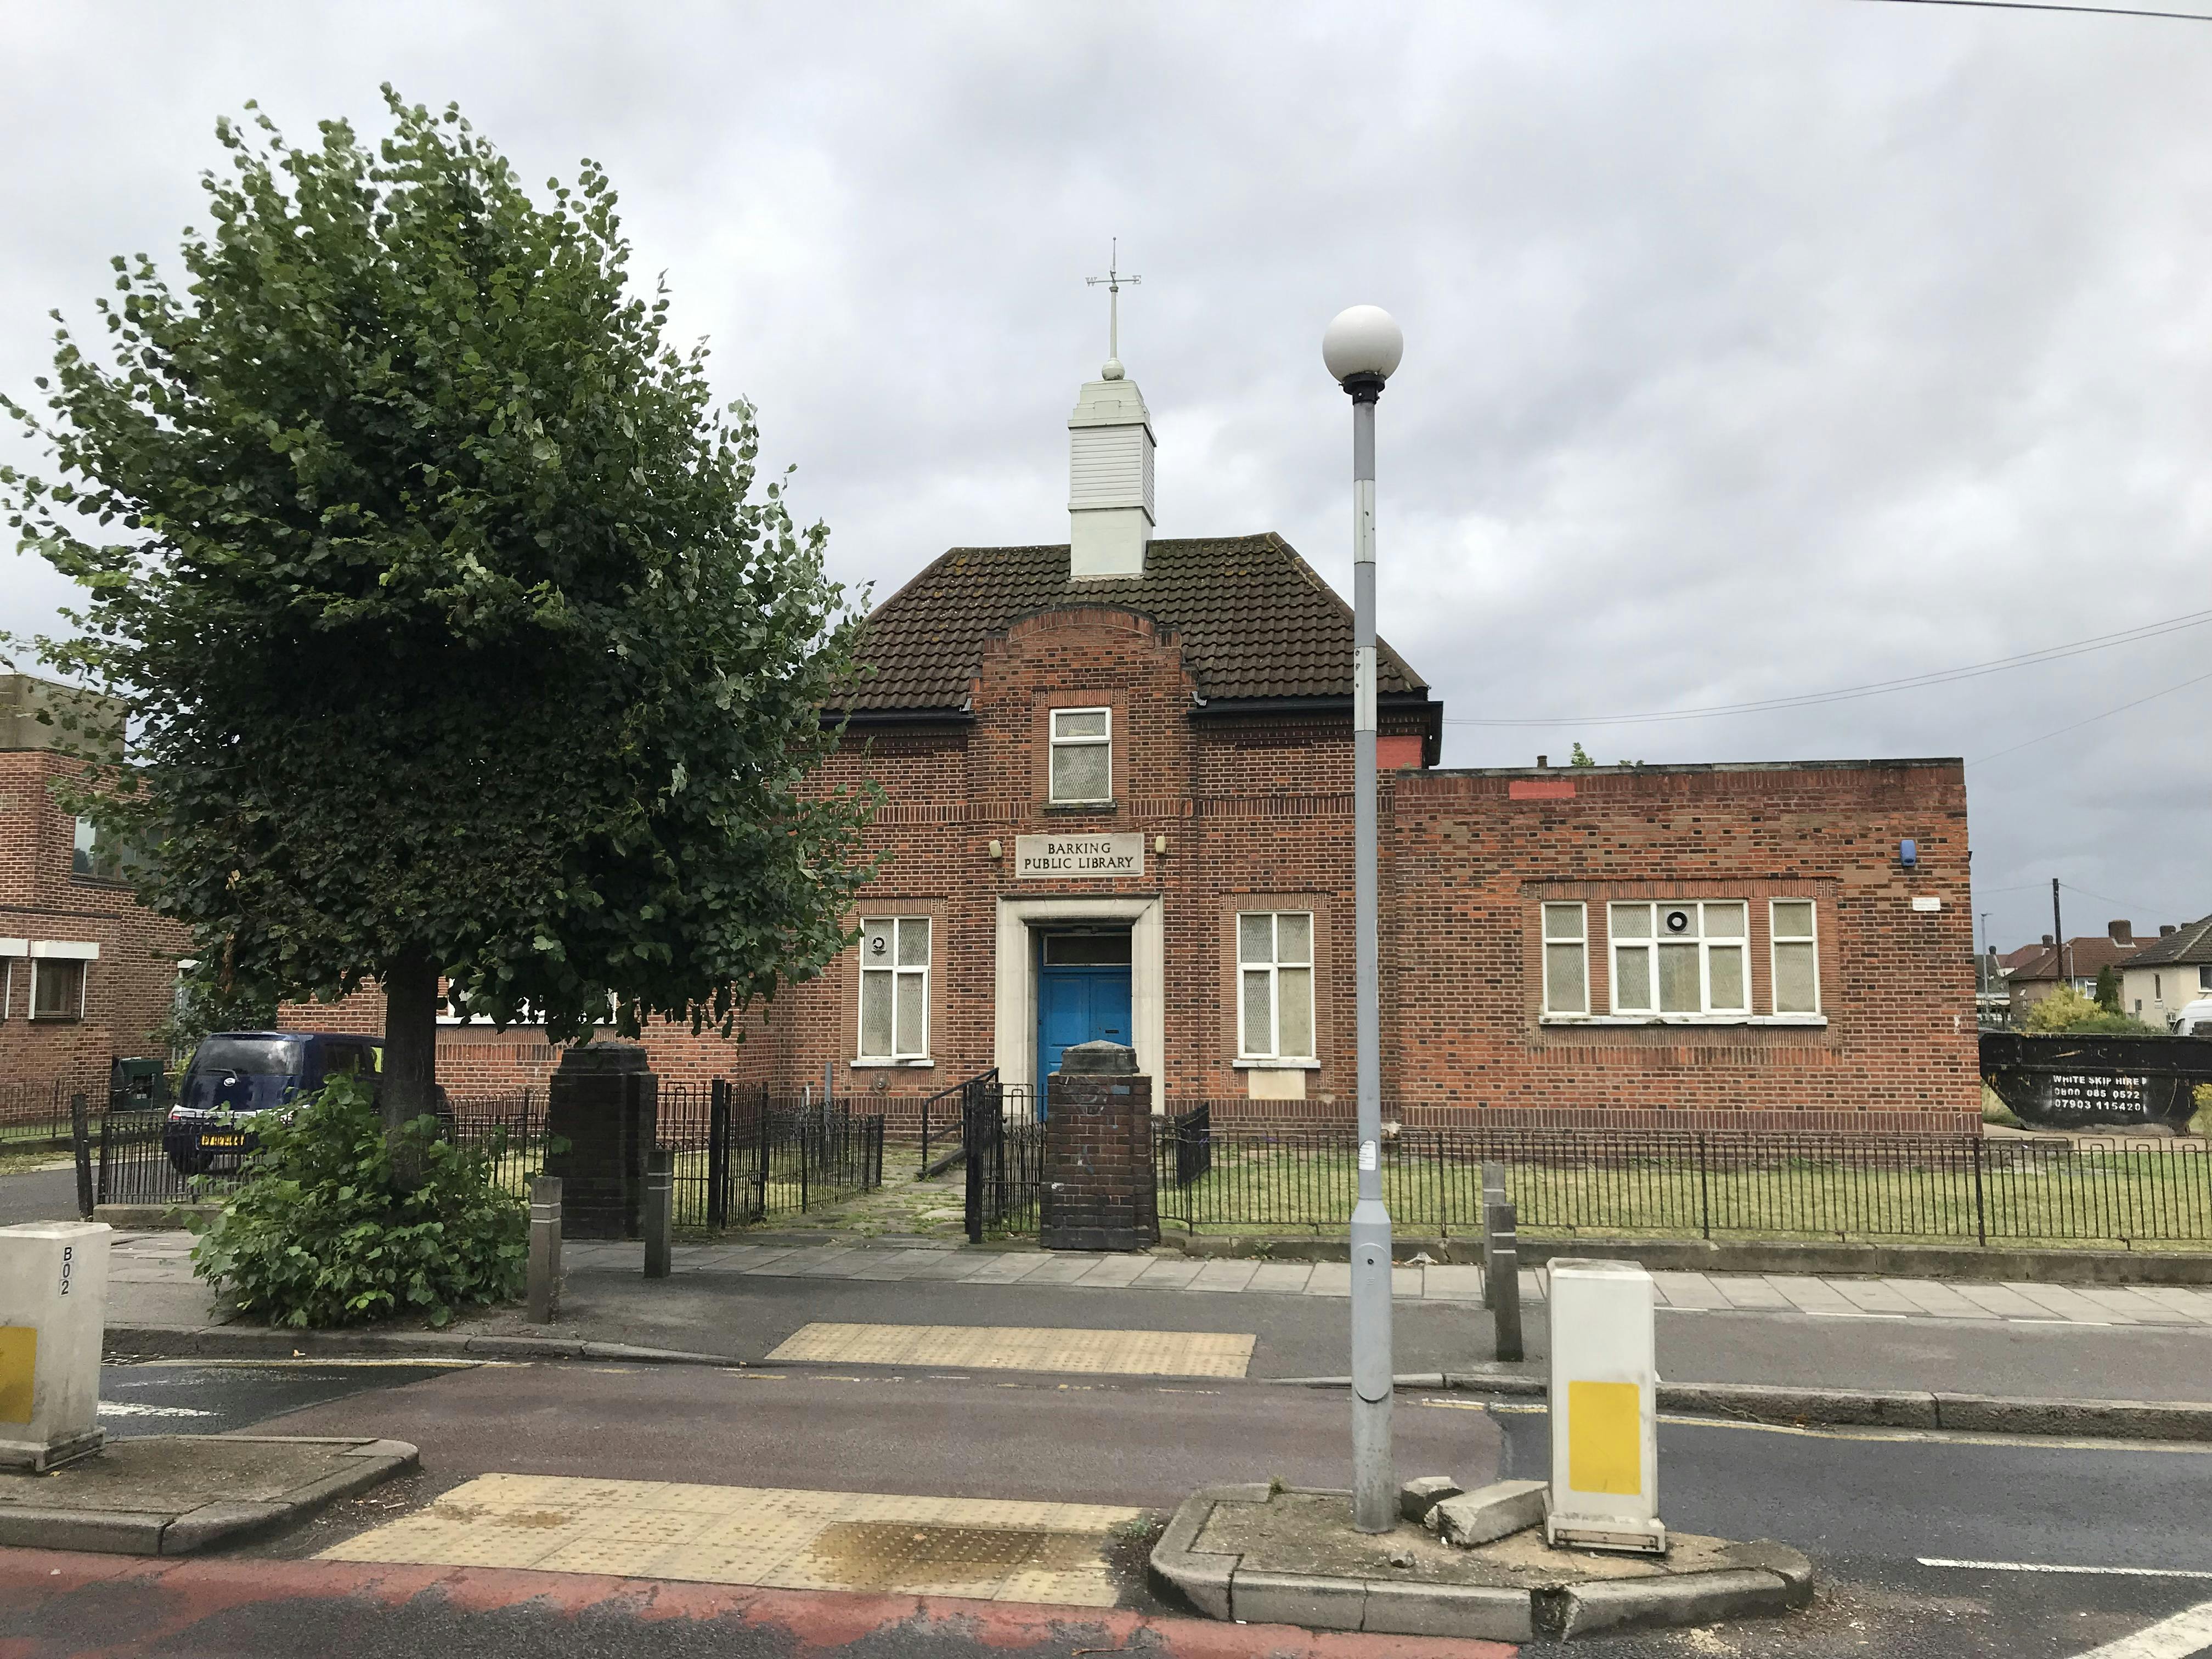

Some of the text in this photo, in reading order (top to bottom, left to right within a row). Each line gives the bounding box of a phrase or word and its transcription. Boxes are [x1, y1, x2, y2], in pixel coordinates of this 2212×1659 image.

[1048, 843, 1111, 854] BARKING
[1024, 856, 1134, 869] PUBLIC LIBRARY
[2053, 1075, 2085, 1084] WHITE
[2089, 1076, 2112, 1085] SKIP
[2055, 1087, 2140, 1099] 0800 085 0522
[2055, 1099, 2141, 1111] 07903 115420
